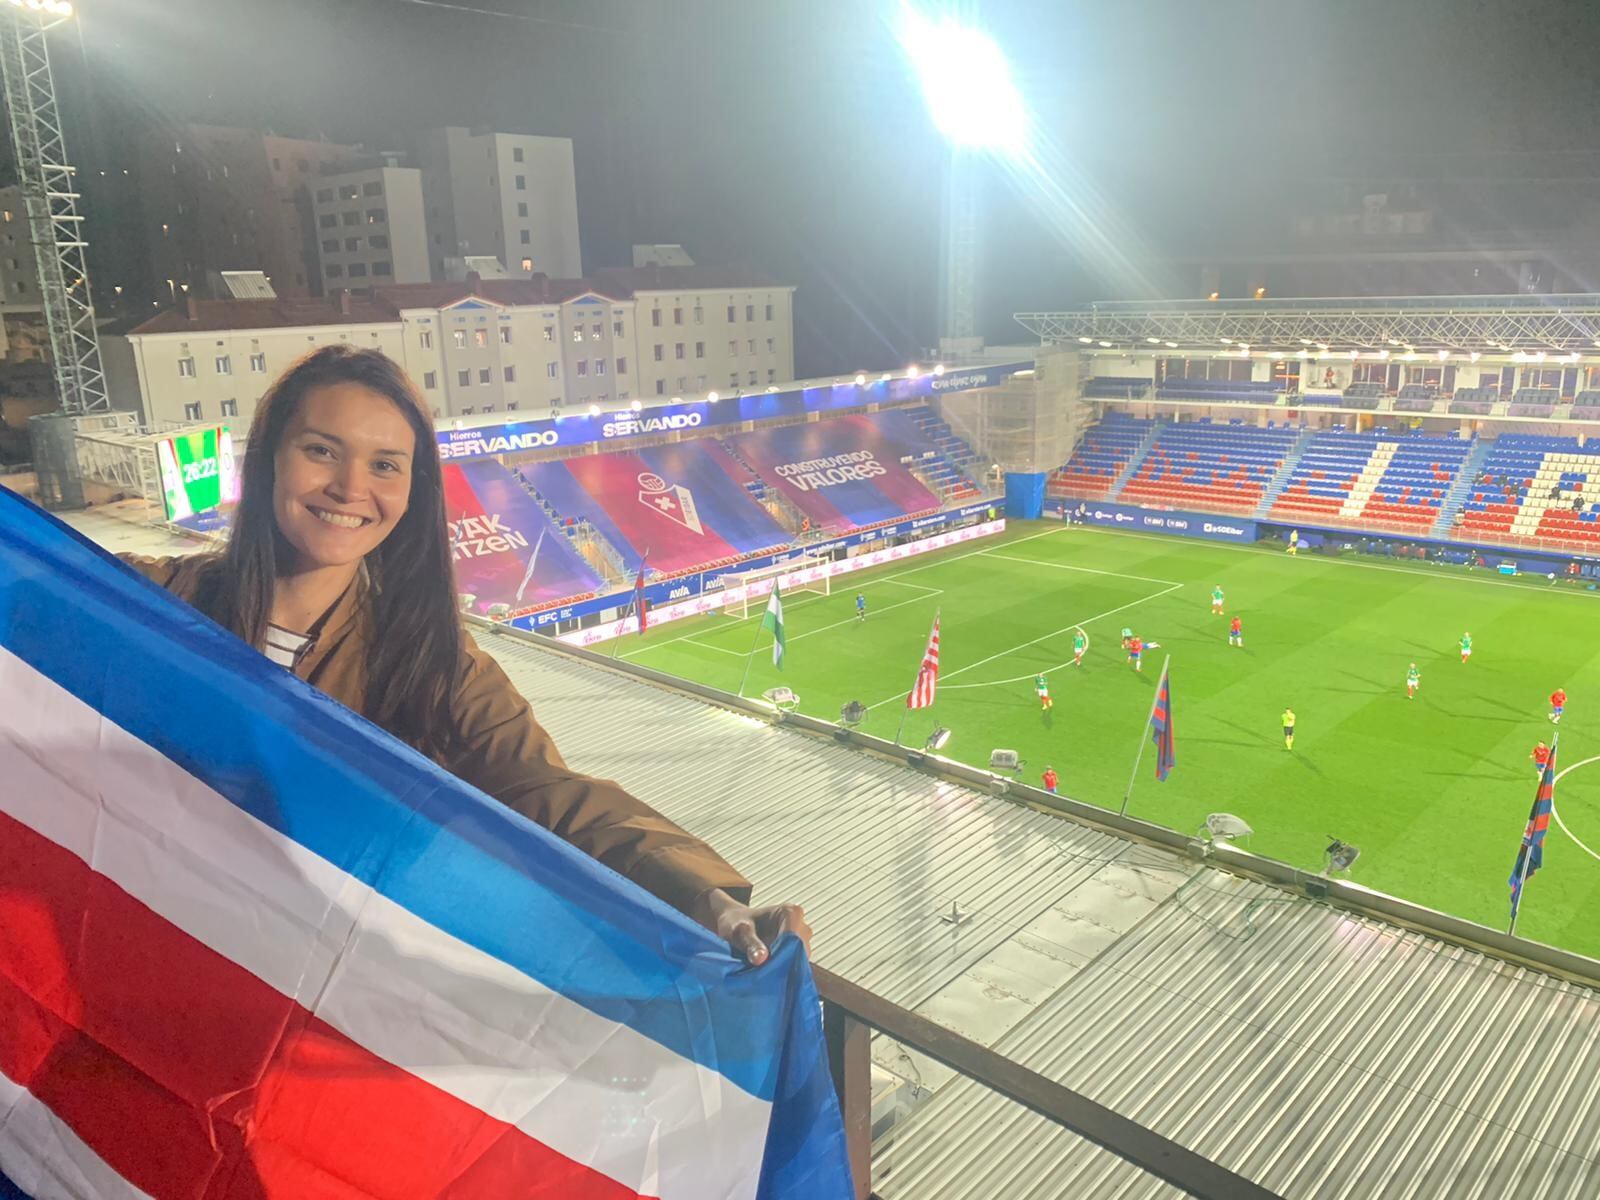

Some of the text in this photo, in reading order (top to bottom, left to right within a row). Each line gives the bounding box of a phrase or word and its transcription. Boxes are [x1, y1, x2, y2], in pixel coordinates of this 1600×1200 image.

[602, 412, 701, 438] SERVANDO
[438, 430, 558, 459] SERVANDO
[449, 431, 482, 441] Hierros
[774, 450, 874, 477] CONSTRUYENDO
[669, 585, 690, 600] AVIA
[538, 612, 558, 625] EFC
